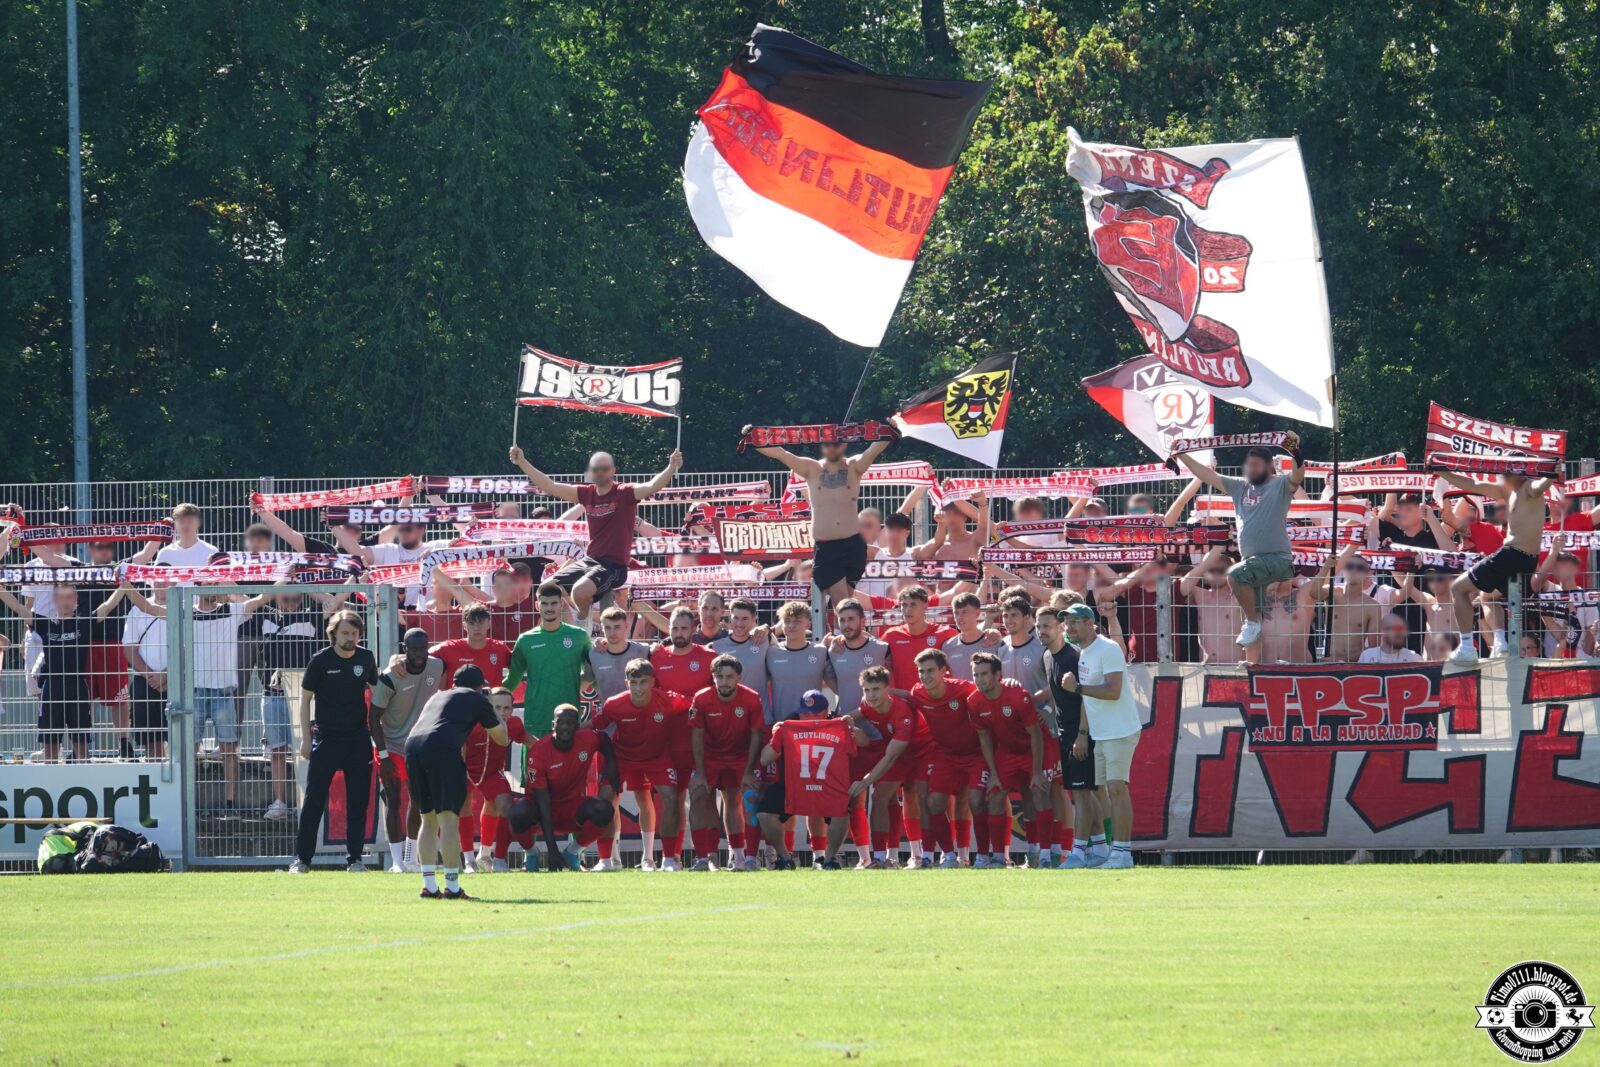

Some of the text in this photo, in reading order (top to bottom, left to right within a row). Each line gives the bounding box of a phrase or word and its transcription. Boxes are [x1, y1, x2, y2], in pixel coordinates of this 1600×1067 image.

[1440, 410, 1561, 451] SZENE E
[1174, 431, 1287, 451] REUTLINGEN
[1452, 435, 1489, 456] SEIT
[447, 476, 530, 494] BLOCK
[1341, 475, 1434, 488] SSV REUTLING
[348, 505, 472, 524] BLOCK E
[983, 552, 1021, 561] SZENE
[1046, 551, 1122, 561] REUTLINGEN
[1124, 550, 1155, 560] 2005
[25, 567, 53, 582] FÜR
[56, 567, 116, 581] STUTTG
[866, 561, 917, 577] OCK
[778, 587, 808, 598] 2005
[1253, 673, 1432, 729] TPSP
[793, 731, 841, 744] REUTLINGEN
[1263, 722, 1423, 743] NO A LA AUTORIDAD
[800, 744, 835, 780] 17
[0, 774, 159, 844] port
